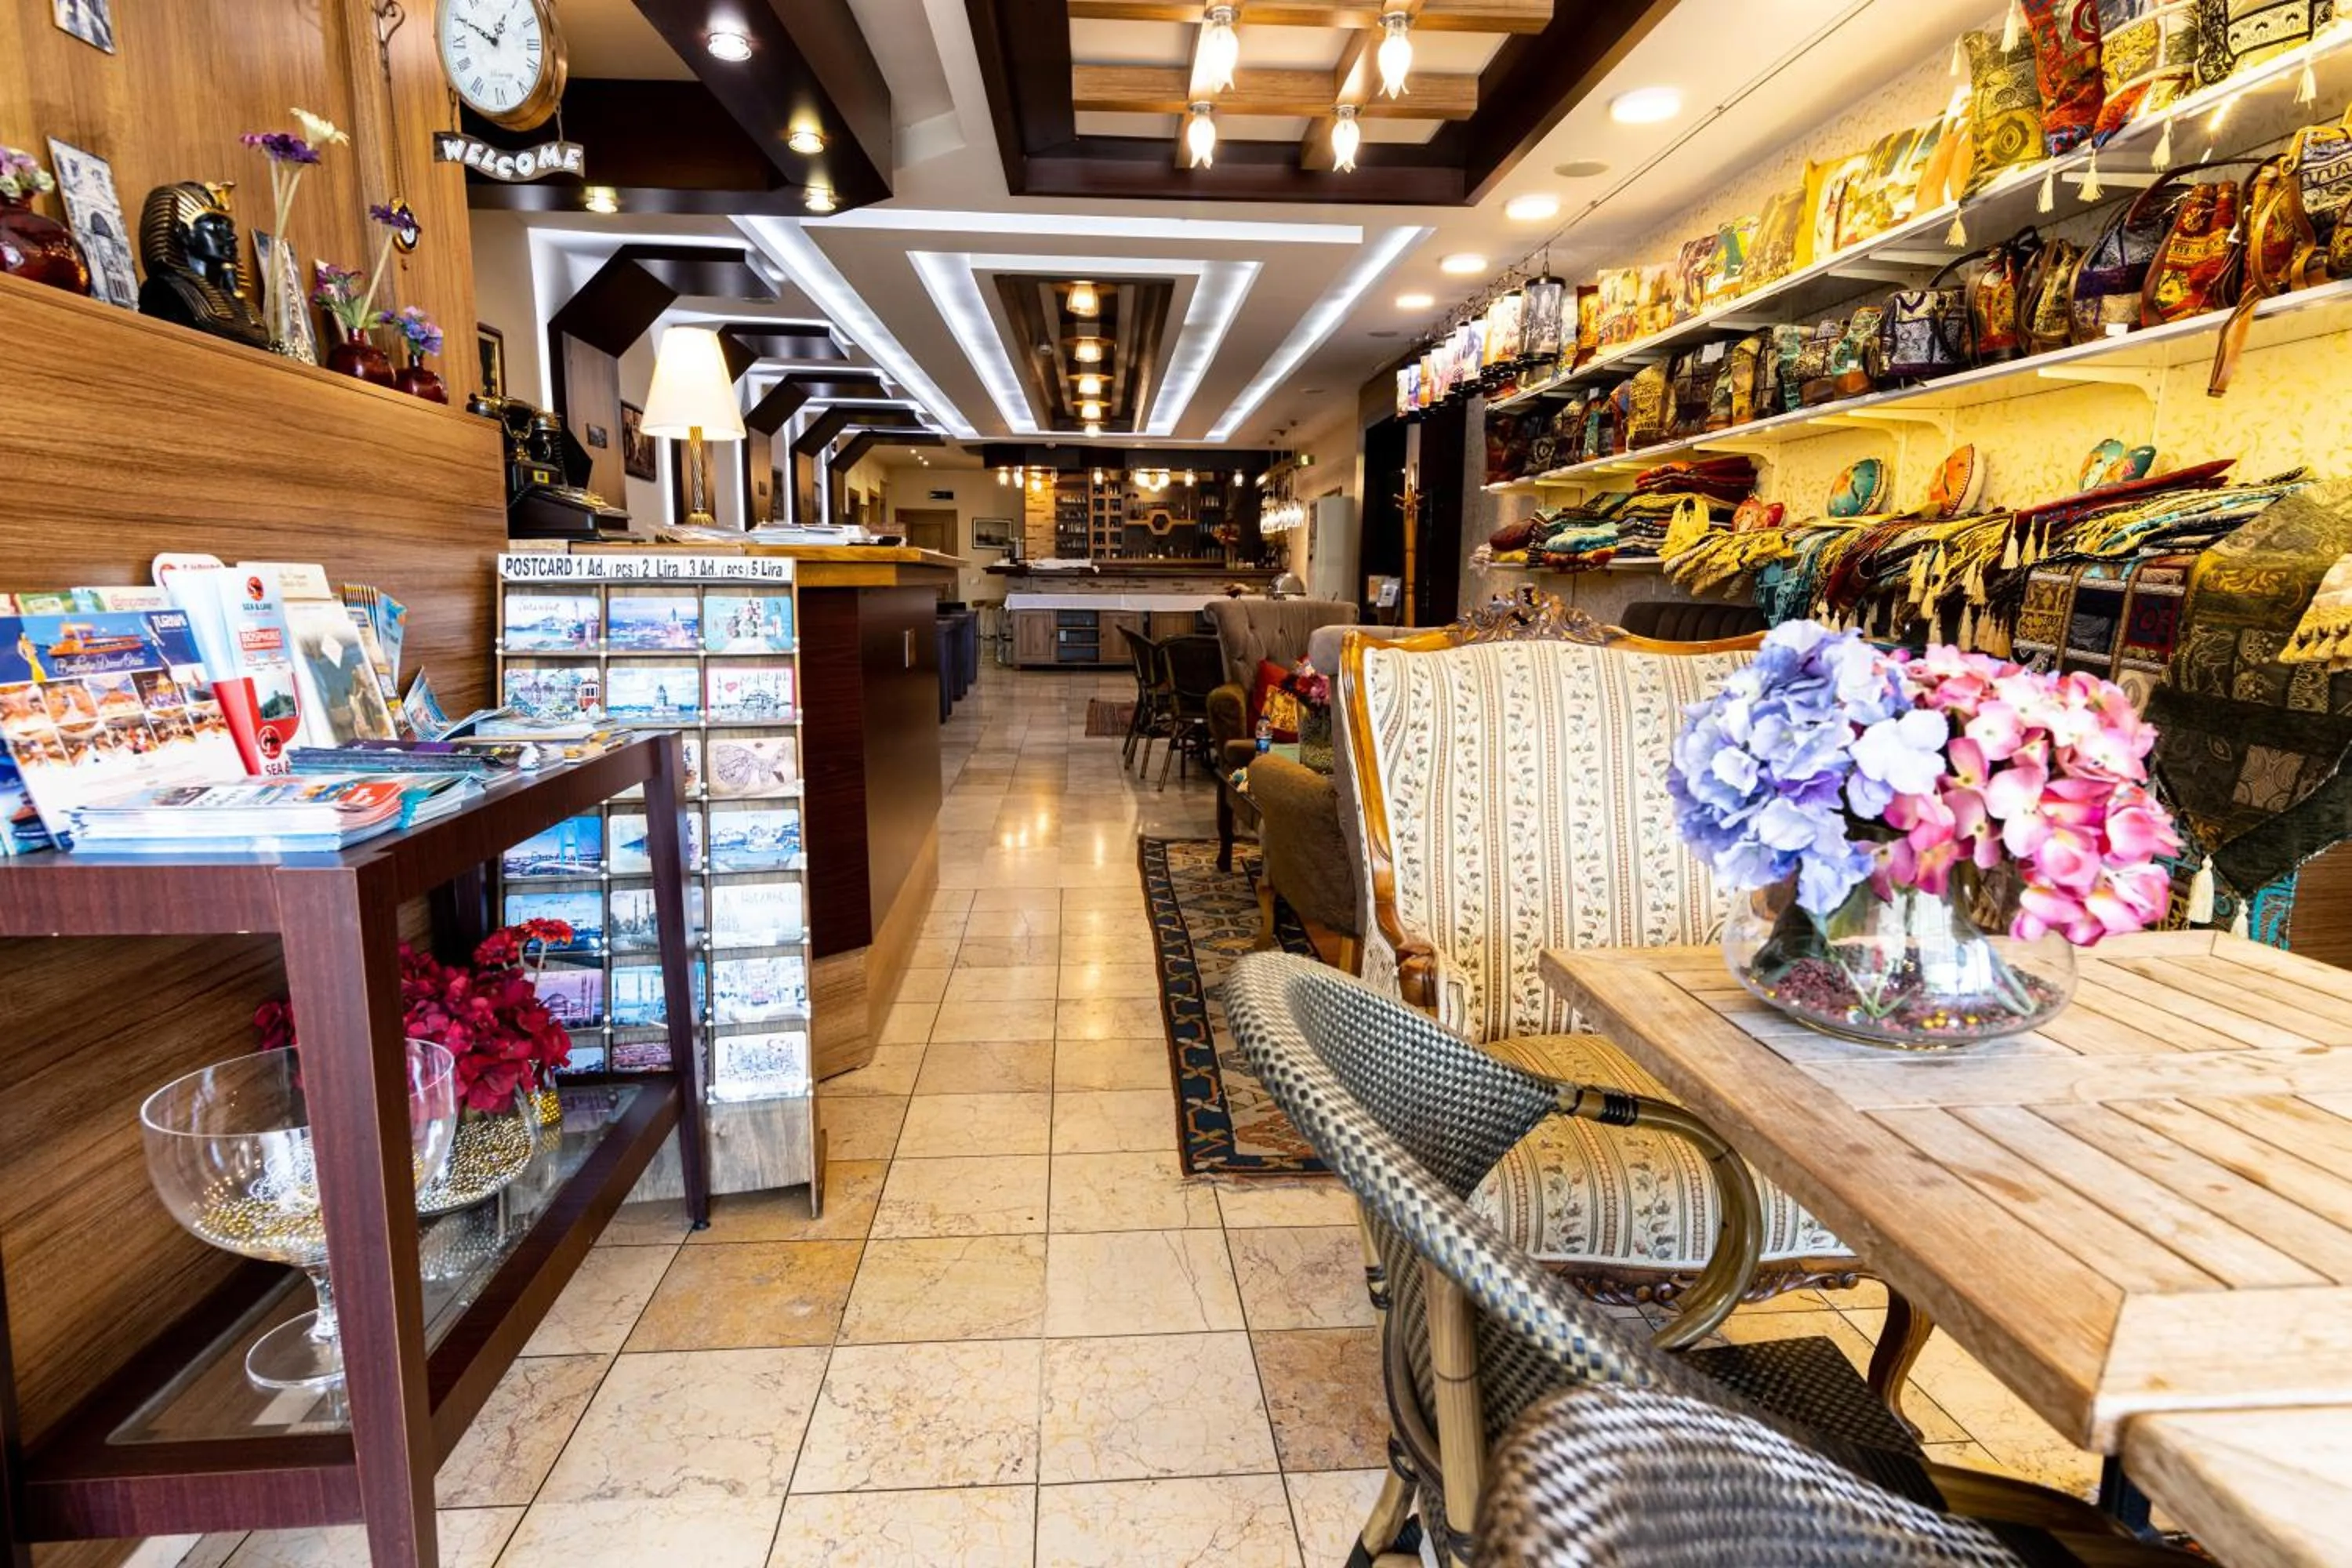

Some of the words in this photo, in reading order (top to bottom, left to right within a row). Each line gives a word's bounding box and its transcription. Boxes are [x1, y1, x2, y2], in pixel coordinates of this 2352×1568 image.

[442, 139, 583, 178] WELCOME
[506, 557, 572, 576] POSTCARD
[577, 557, 583, 576] 1
[642, 558, 650, 577] 2
[656, 559, 678, 577] Lira
[689, 559, 695, 576] 3
[751, 561, 758, 576] 5
[761, 561, 782, 578] Lira
[265, 762, 283, 776] SEA
